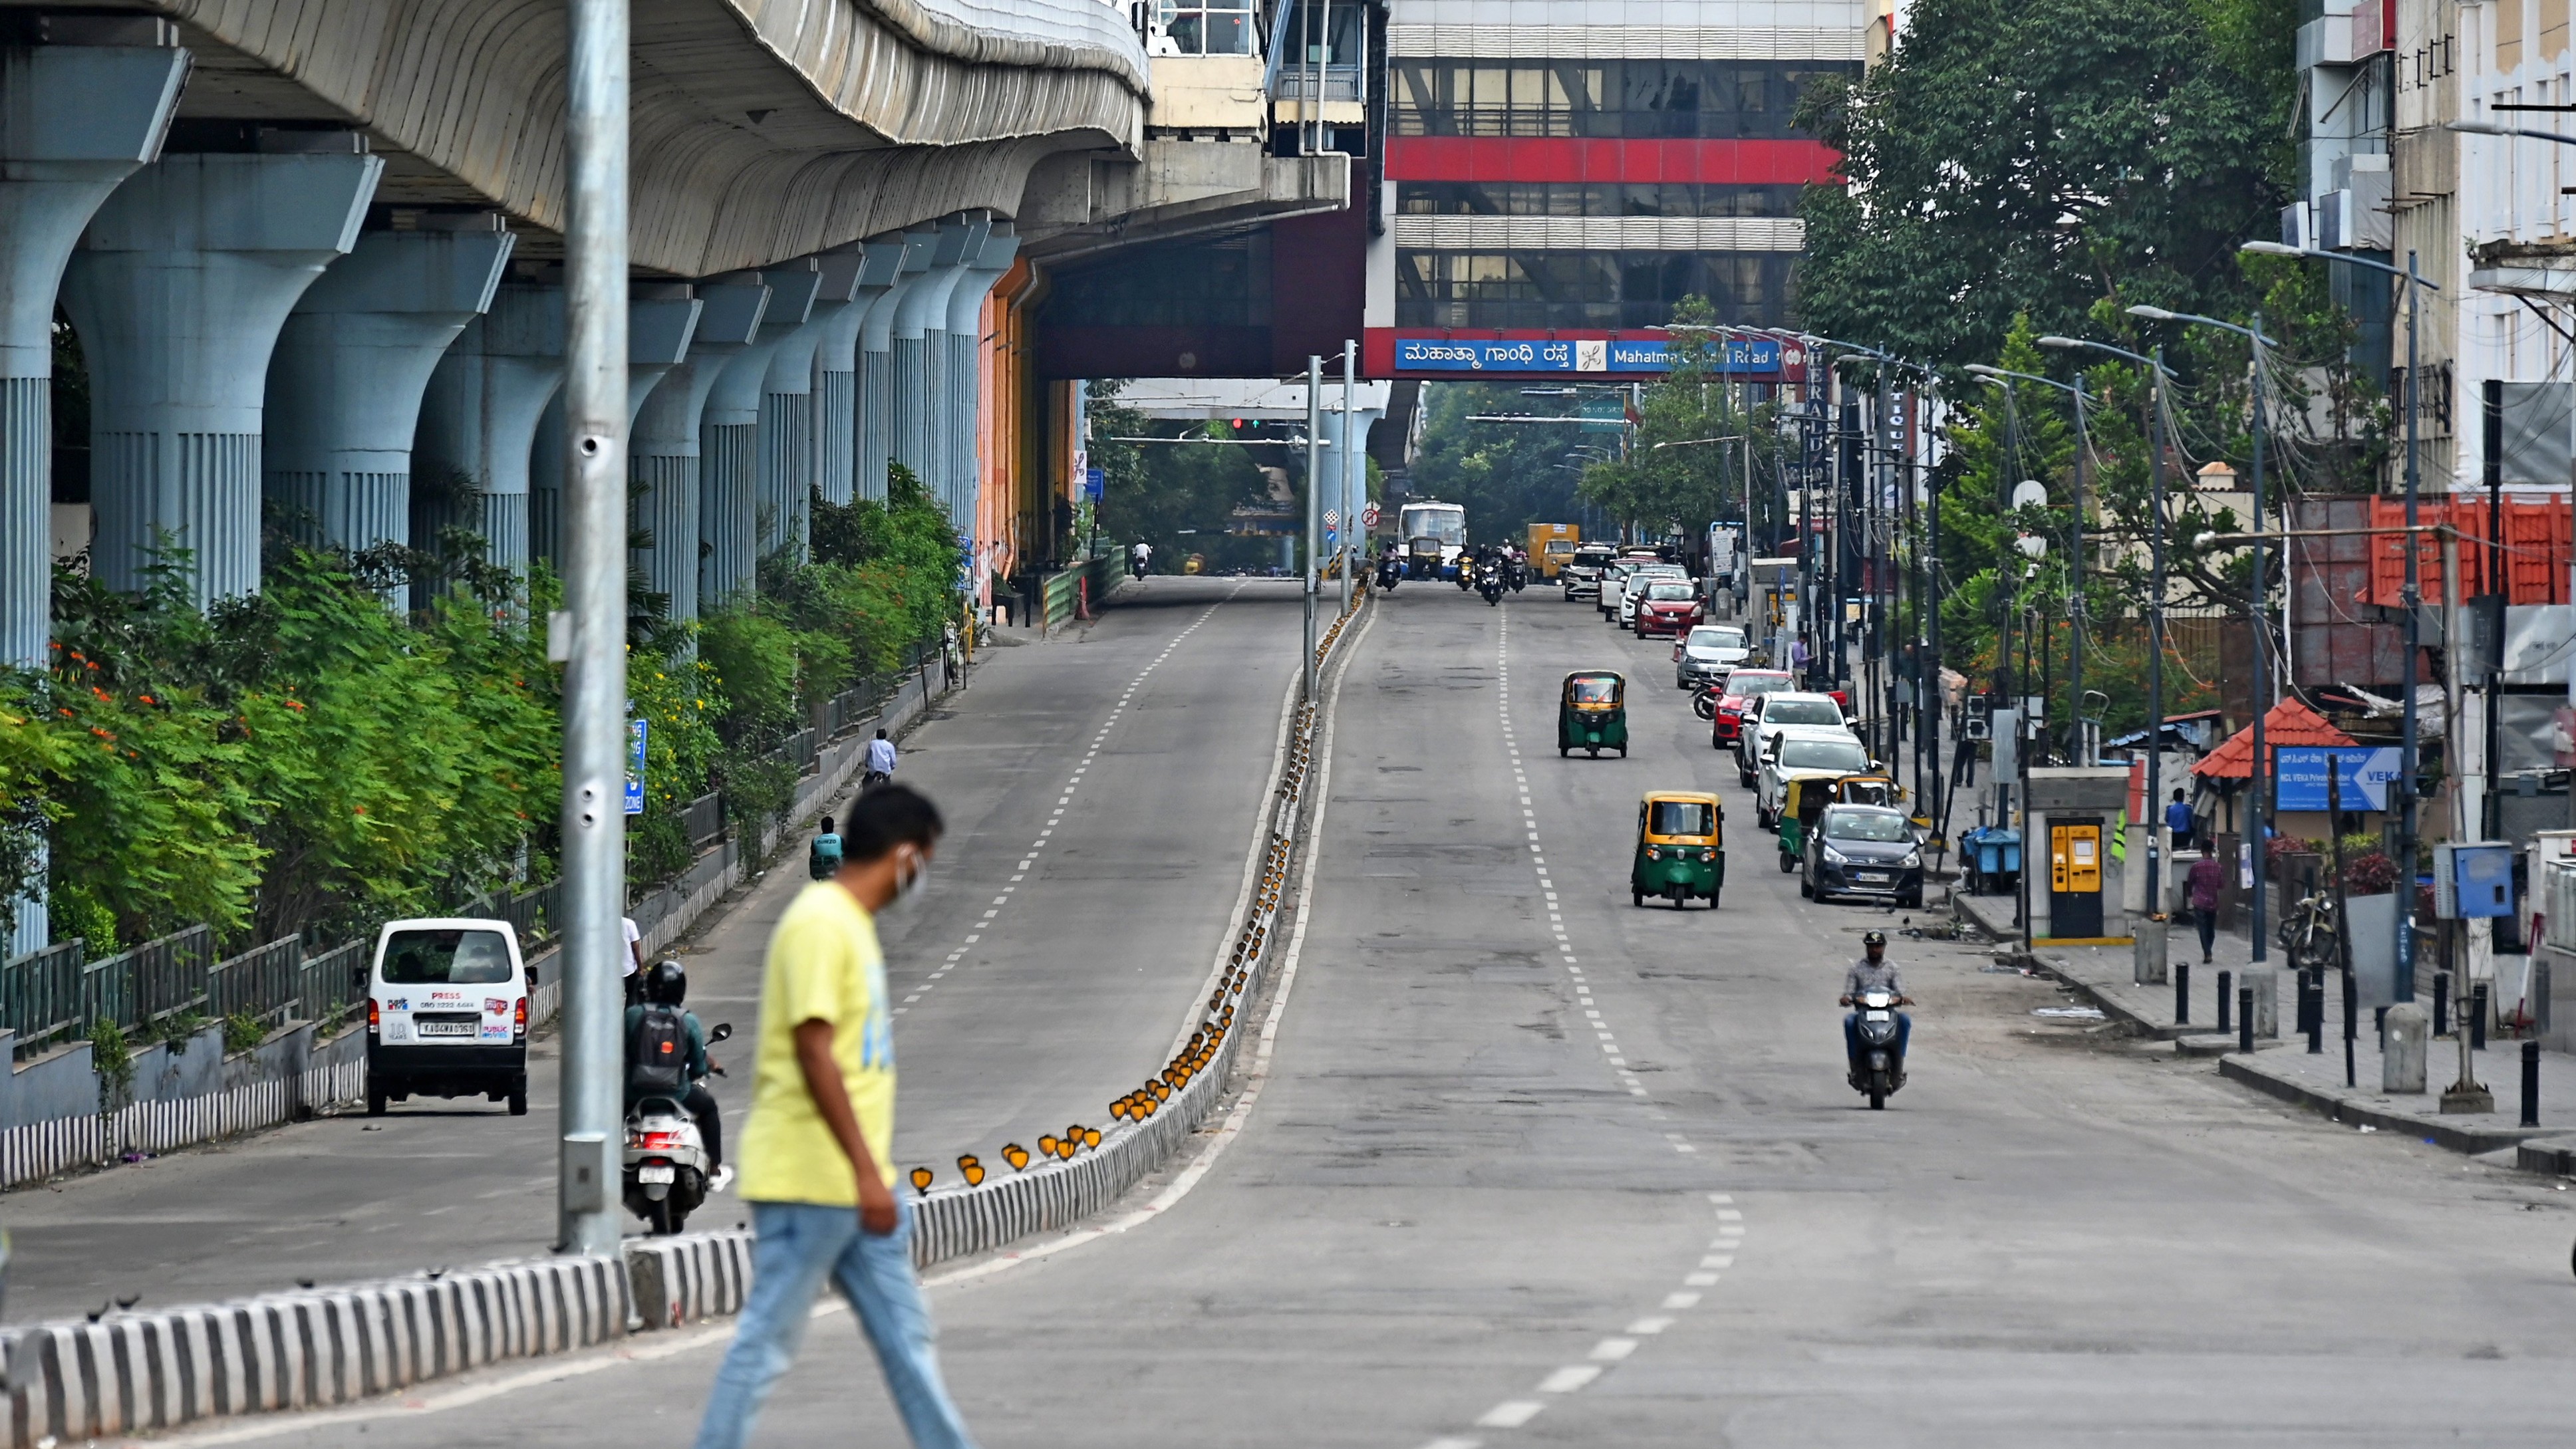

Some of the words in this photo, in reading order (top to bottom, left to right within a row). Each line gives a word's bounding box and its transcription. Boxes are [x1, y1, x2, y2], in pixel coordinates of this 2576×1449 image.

[1485, 344, 1534, 364] ಗಾಂಧಿ
[1543, 344, 1570, 368] ರಸ್ತೆ
[1809, 351, 1824, 452] HERALD
[2293, 773, 2309, 782] VEKA
[625, 795, 641, 809] ZONE
